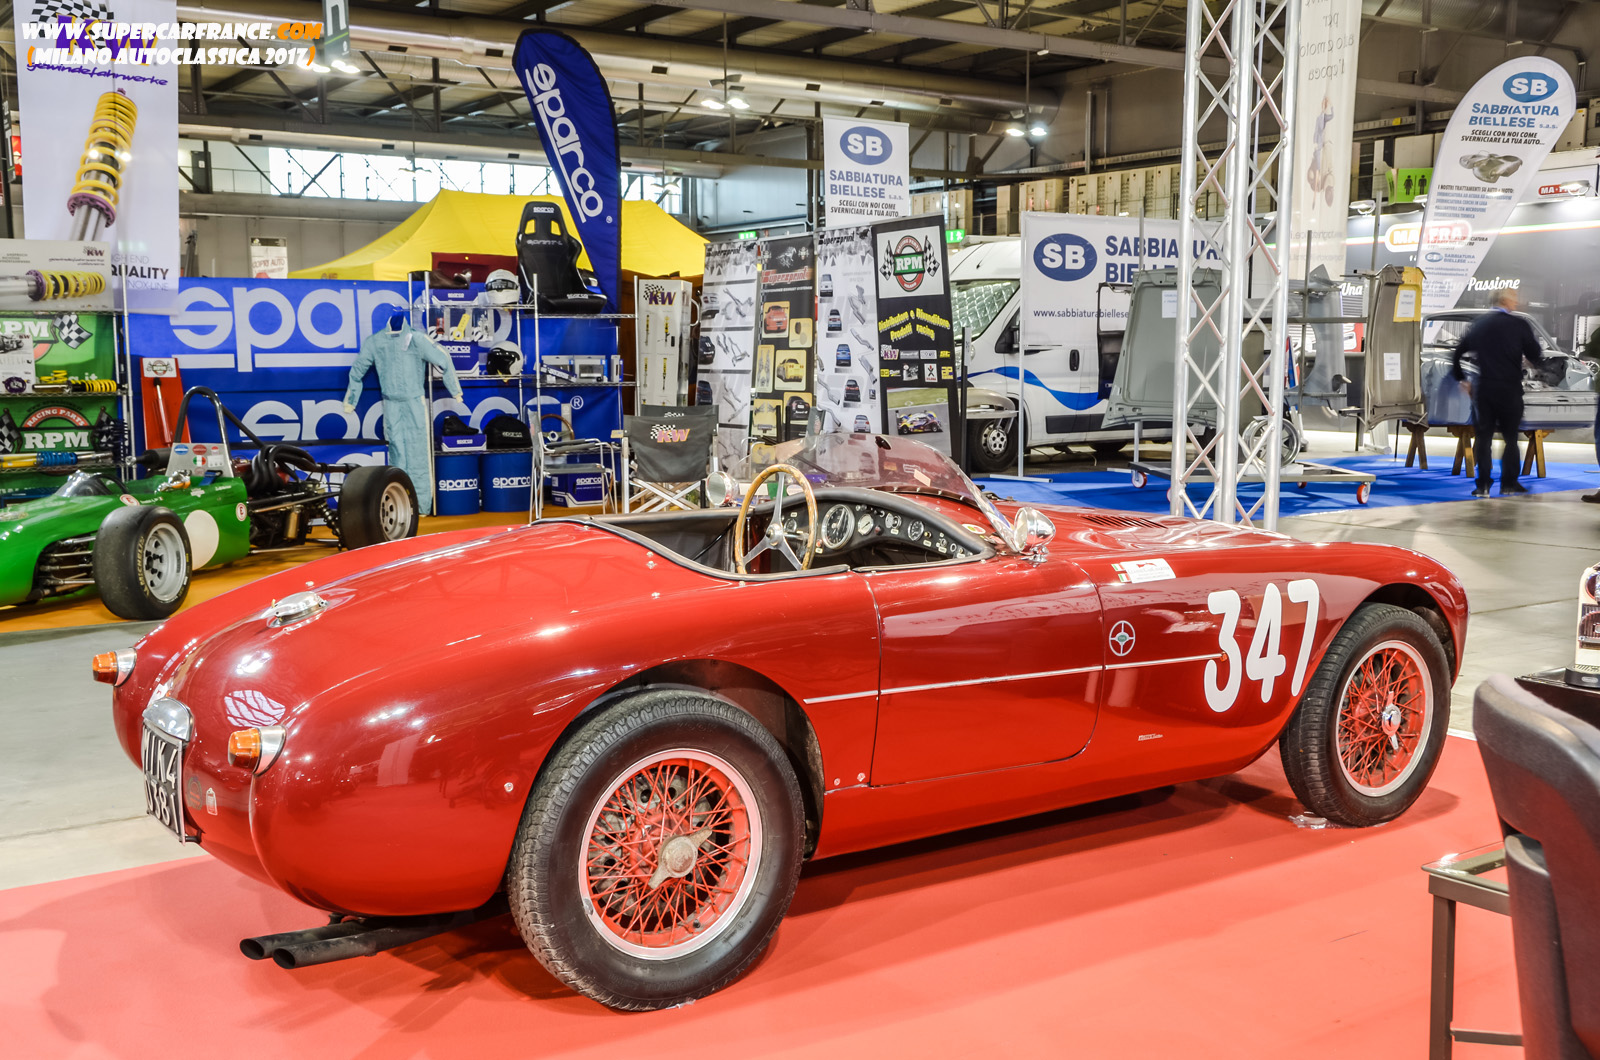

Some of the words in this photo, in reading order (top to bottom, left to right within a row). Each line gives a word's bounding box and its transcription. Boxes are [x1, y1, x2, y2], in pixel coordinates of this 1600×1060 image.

[1510, 77, 1549, 96] SB
[1471, 103, 1559, 116] SABBIATURA
[1469, 116, 1536, 128] BIELLESE
[1461, 135, 1501, 144] SVERNICIARE
[1511, 137, 1523, 145] TUA
[1471, 129, 1492, 137] SCEGLI
[525, 63, 604, 223] sparco
[847, 133, 884, 157] SB
[829, 169, 904, 187] SABBIATURA
[830, 184, 886, 199] BIELLESE
[830, 207, 866, 216] SVERNICIARE
[839, 200, 858, 208] SCEGLI
[881, 202, 896, 210] COME
[1105, 235, 1222, 261] SABBIAUR
[111, 255, 127, 264] IGH
[130, 255, 150, 265] END
[896, 256, 923, 271] RPM
[1042, 243, 1086, 270] SB
[111, 264, 169, 281] QUALITY
[127, 280, 169, 292] NOX-LINE
[1340, 283, 1363, 297] Una
[1468, 277, 1521, 291] Passione
[649, 292, 676, 306] KW
[27, 409, 58, 428] RACING
[59, 409, 86, 427] PARTS
[24, 432, 89, 449] RPM
[656, 429, 692, 443] KW
[439, 479, 478, 491] sparco
[493, 477, 531, 489] sparco
[1204, 579, 1320, 713] 347
